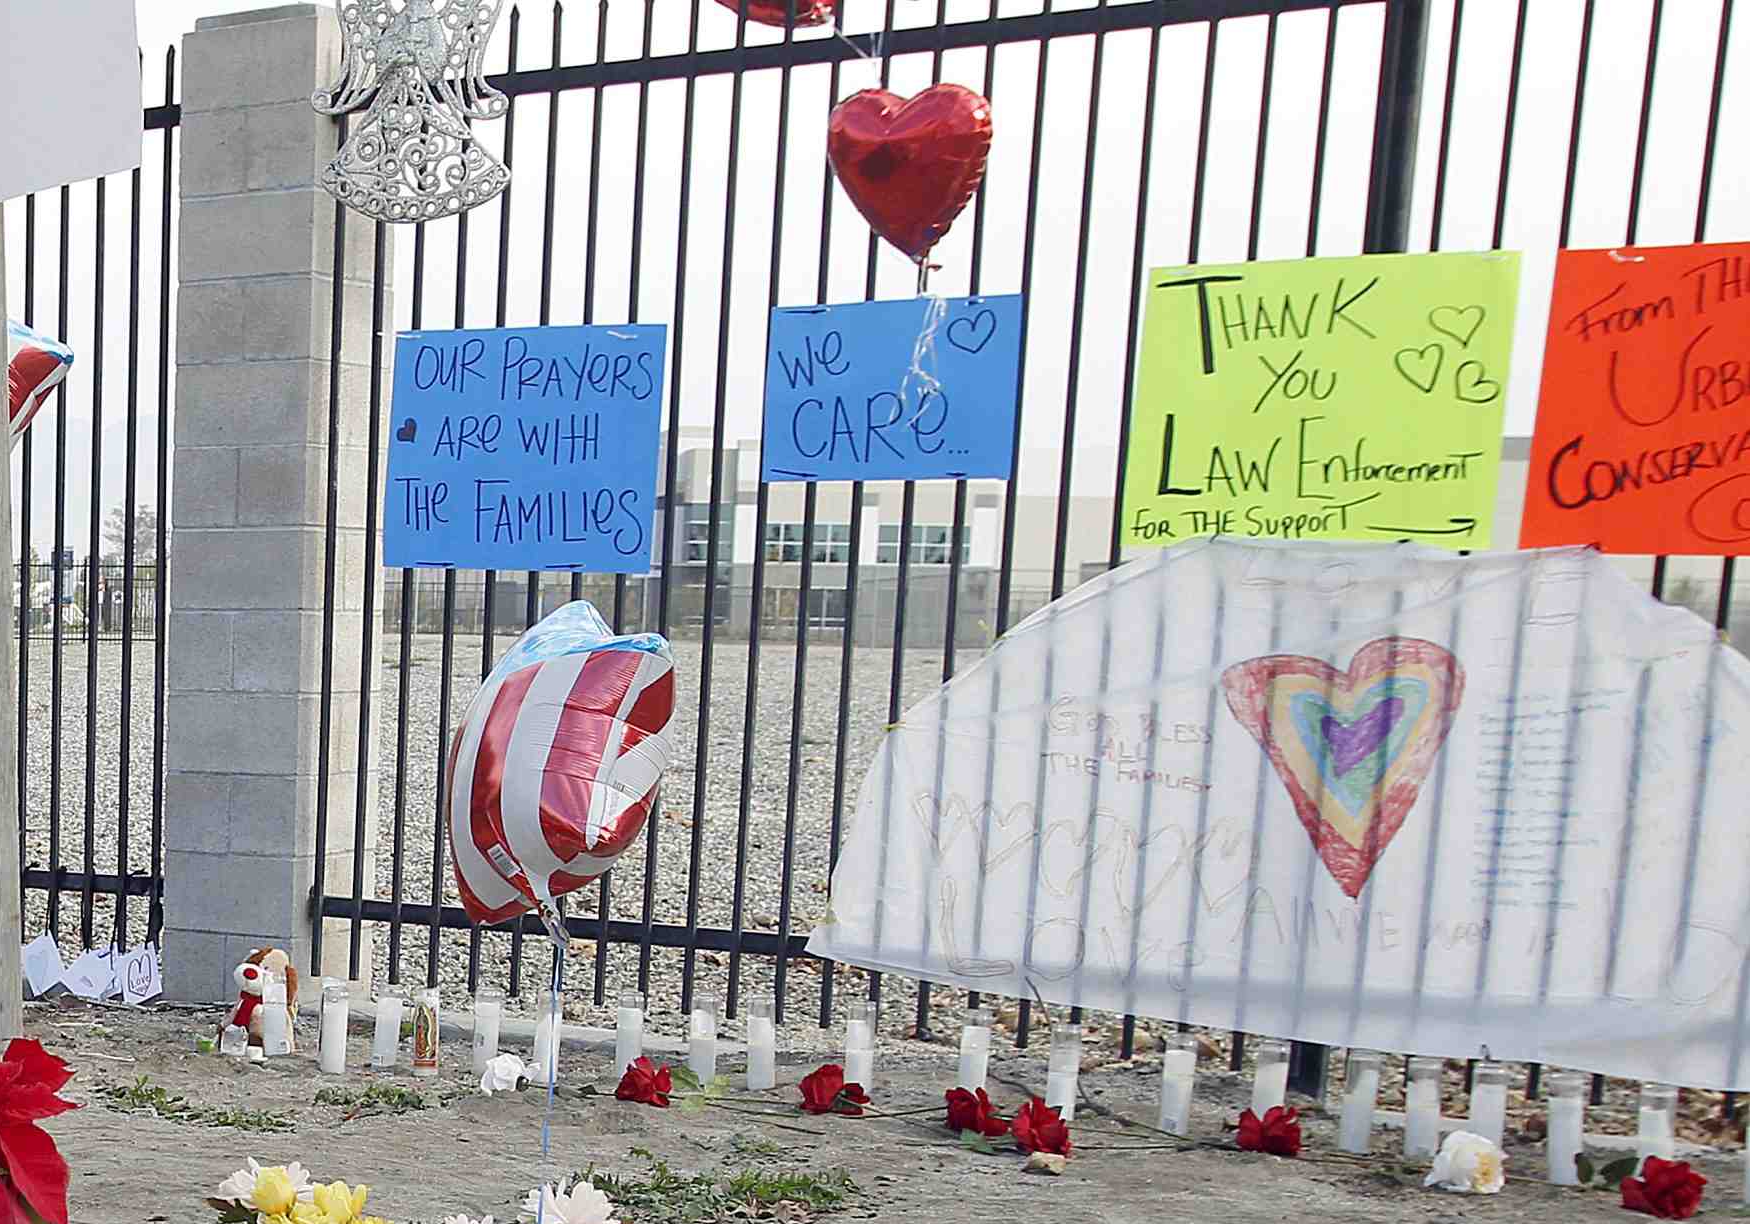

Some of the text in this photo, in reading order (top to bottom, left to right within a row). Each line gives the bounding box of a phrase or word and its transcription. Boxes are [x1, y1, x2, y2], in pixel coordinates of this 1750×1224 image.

[1156, 275, 1380, 375] THANK
[1564, 256, 1750, 342] From TH
[415, 337, 486, 393] OUR
[1253, 350, 1337, 414] YOU
[1609, 325, 1750, 428] URB
[518, 413, 601, 466] WITH
[1158, 414, 1282, 497] LAW
[1181, 509, 1237, 534] THE
